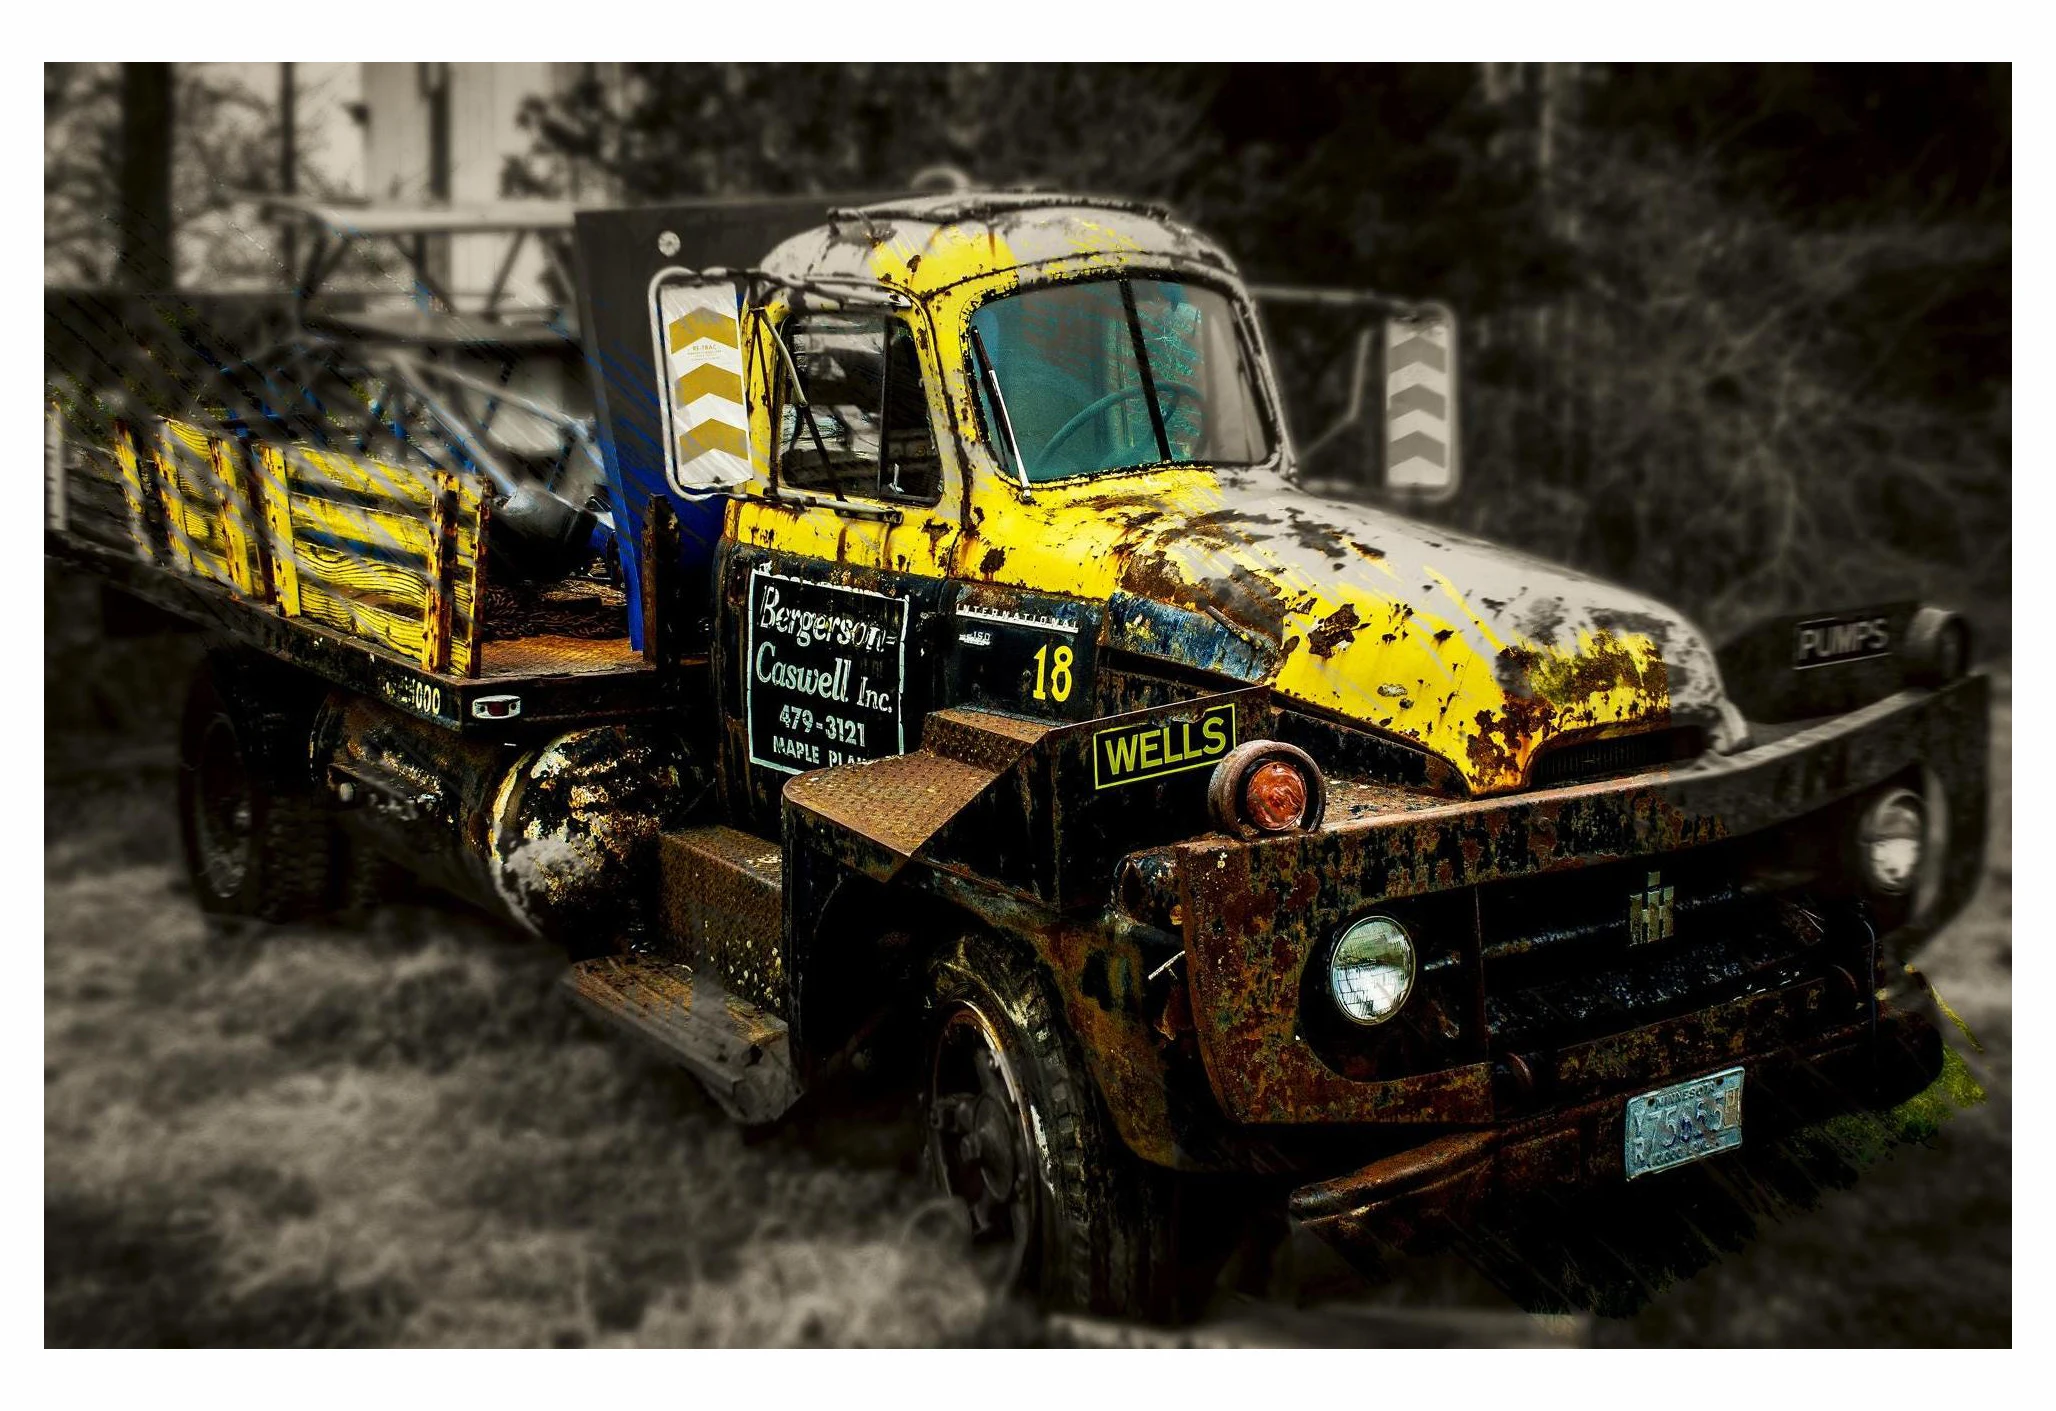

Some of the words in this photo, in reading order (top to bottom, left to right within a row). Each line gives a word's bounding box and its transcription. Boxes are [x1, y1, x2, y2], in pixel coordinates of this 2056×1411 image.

[956, 603, 1078, 632] INTERNATIONAL
[1798, 617, 1889, 660] PUMPS
[756, 641, 852, 702] Caswell
[857, 676, 892, 713] Inc.
[1033, 644, 1073, 702] 18
[779, 704, 866, 747] 479-3121
[1105, 717, 1226, 775] WELLS
[773, 735, 820, 765] MAPLE
[828, 749, 866, 768] PLA
